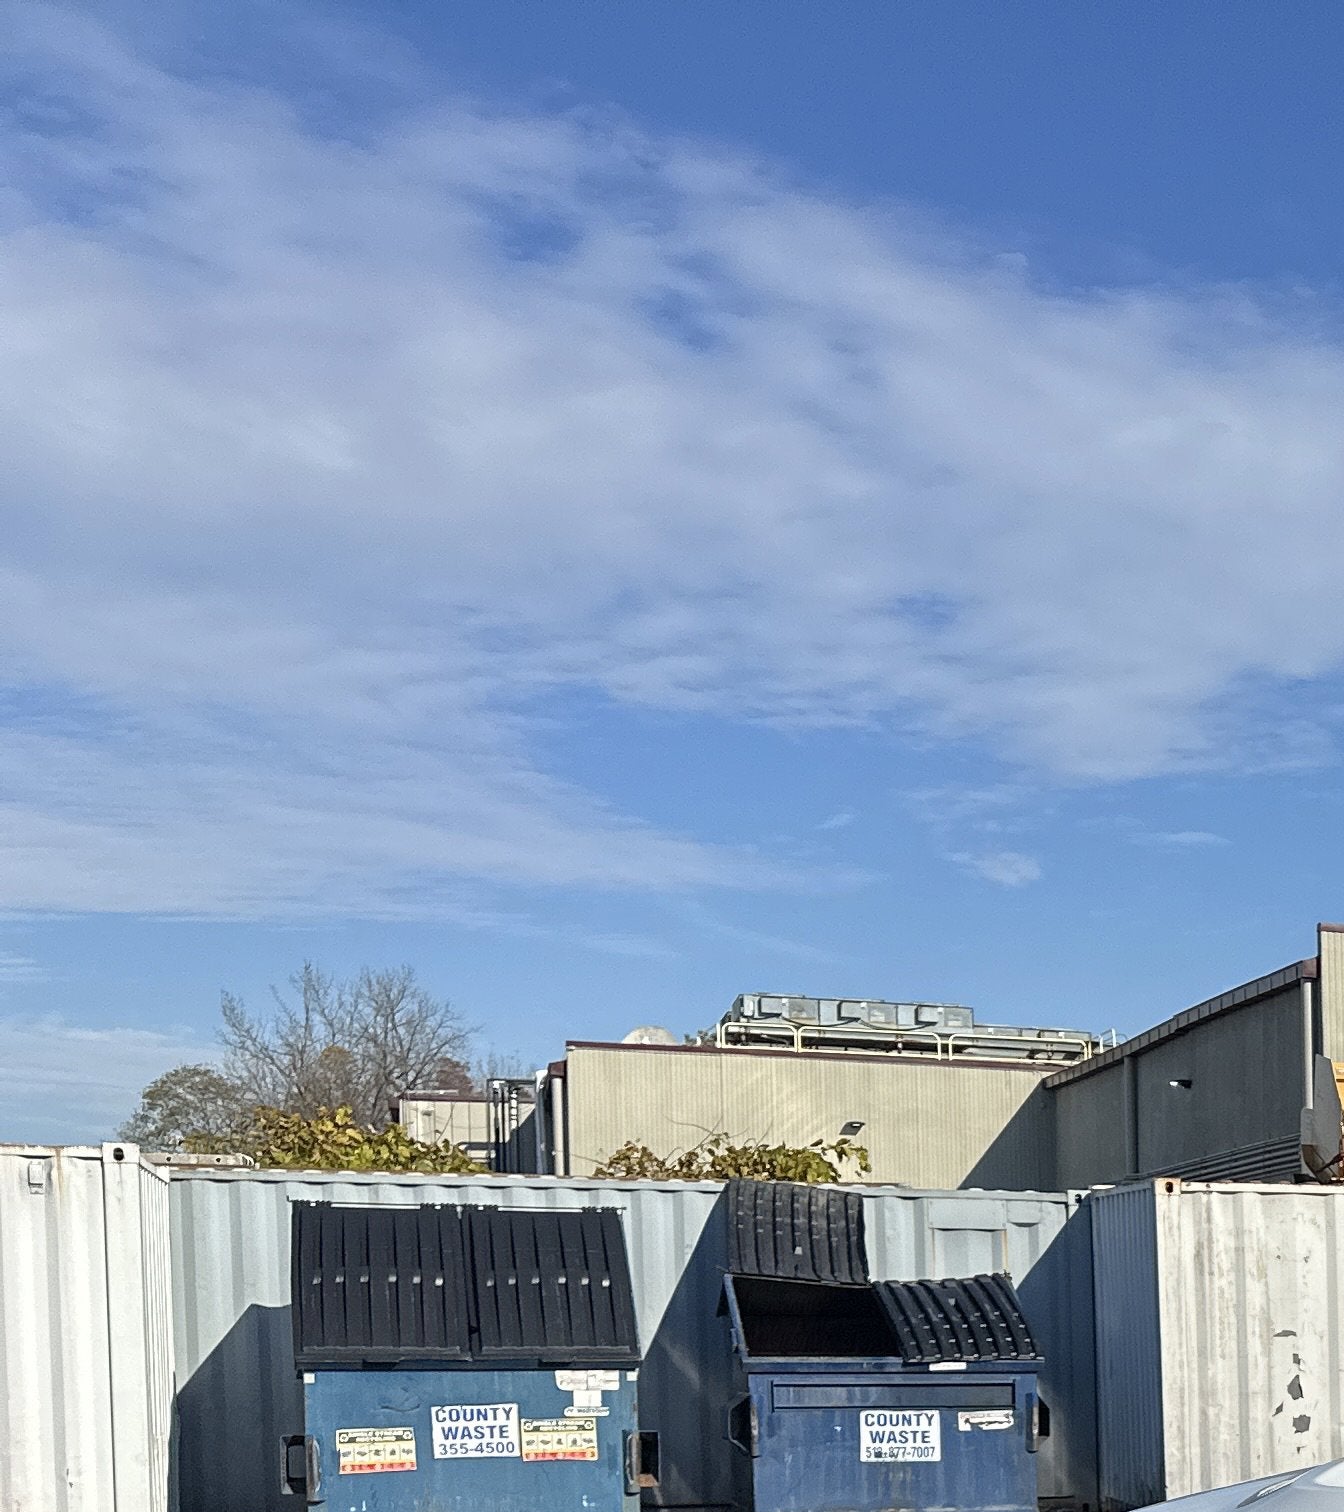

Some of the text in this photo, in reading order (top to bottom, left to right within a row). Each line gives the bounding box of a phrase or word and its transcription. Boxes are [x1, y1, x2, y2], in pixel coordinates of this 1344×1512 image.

[435, 1406, 513, 1423] COUNTY
[864, 1412, 935, 1427] COUNTY
[441, 1425, 510, 1440] WASTE
[869, 1430, 931, 1444] WASTE
[439, 1441, 515, 1455] 355-4500
